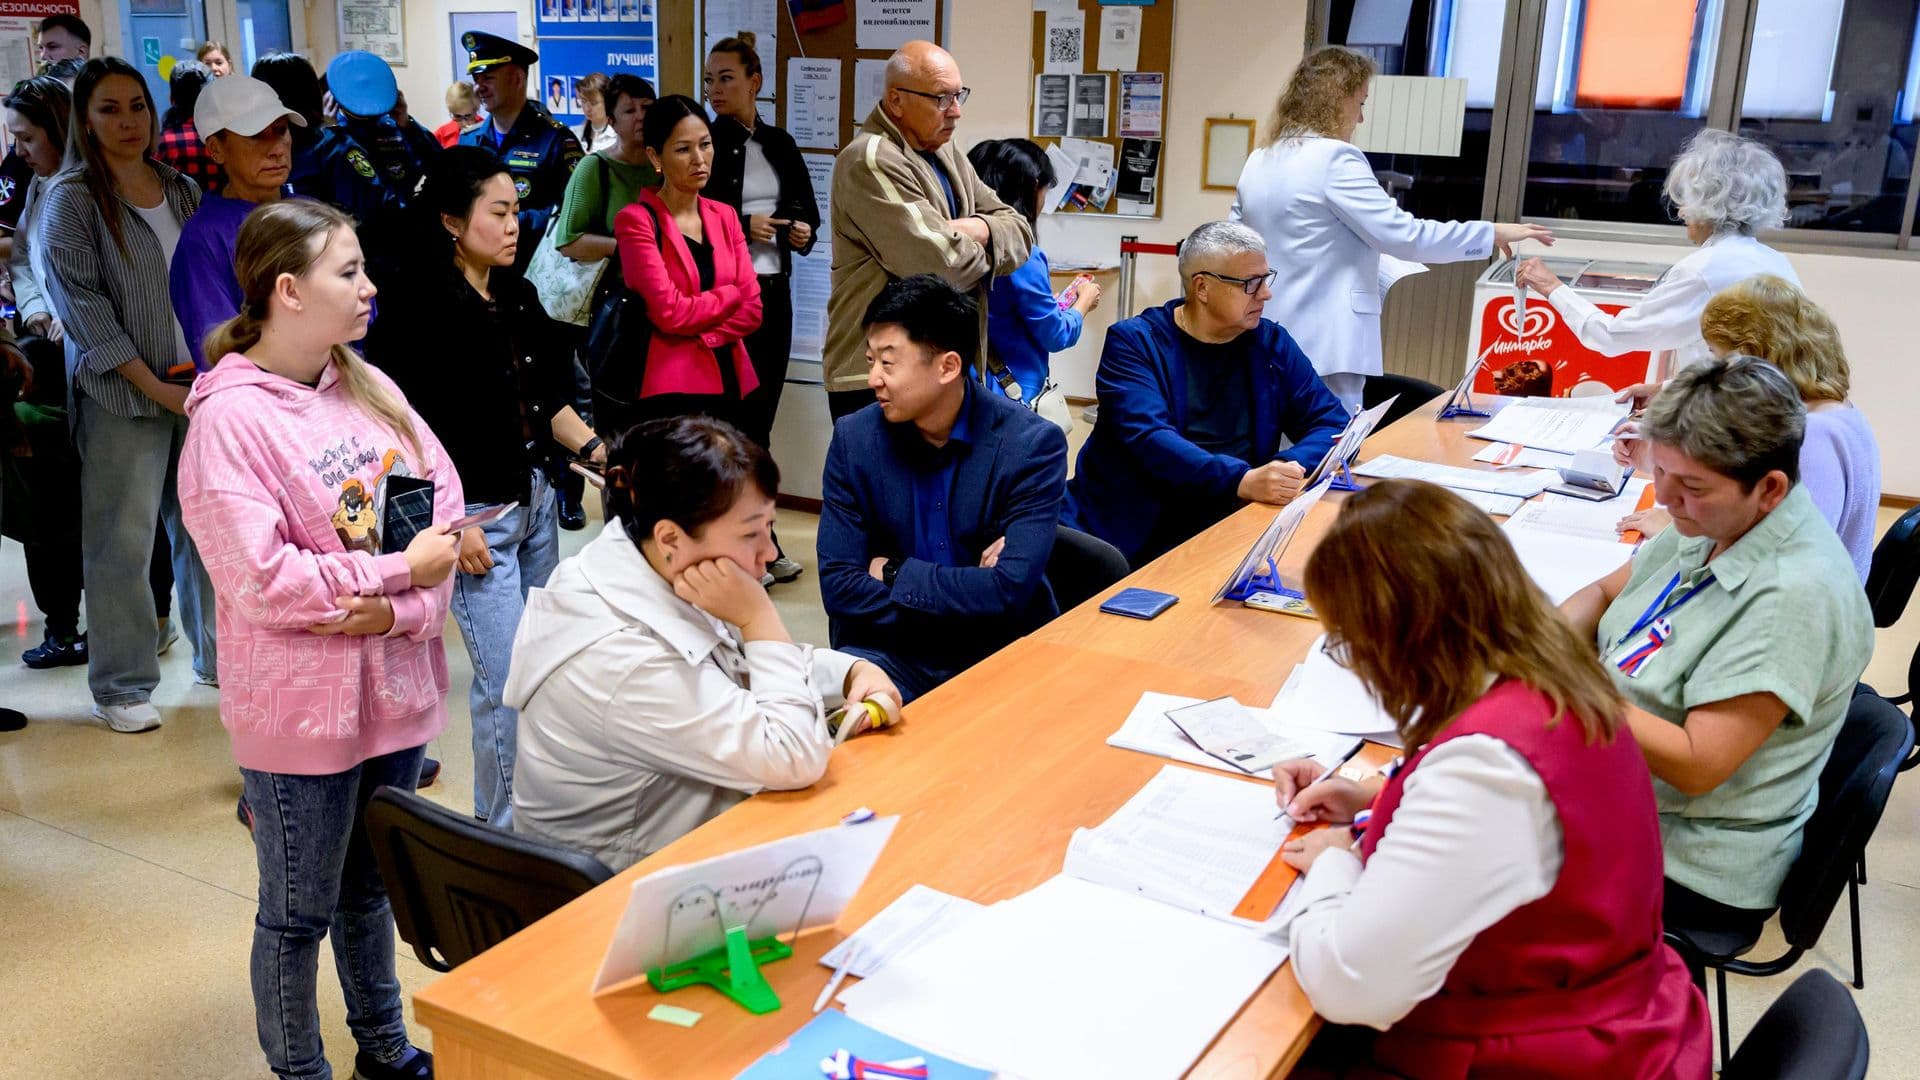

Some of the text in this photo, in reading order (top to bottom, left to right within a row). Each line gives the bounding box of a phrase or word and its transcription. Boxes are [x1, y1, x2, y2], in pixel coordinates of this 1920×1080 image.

[0, 3, 77, 14] ЕЗОПАСНОСТЬ
[863, 18, 930, 26] видеонаблюдение
[1493, 334, 1552, 355] Инмарко
[321, 465, 348, 489] Old
